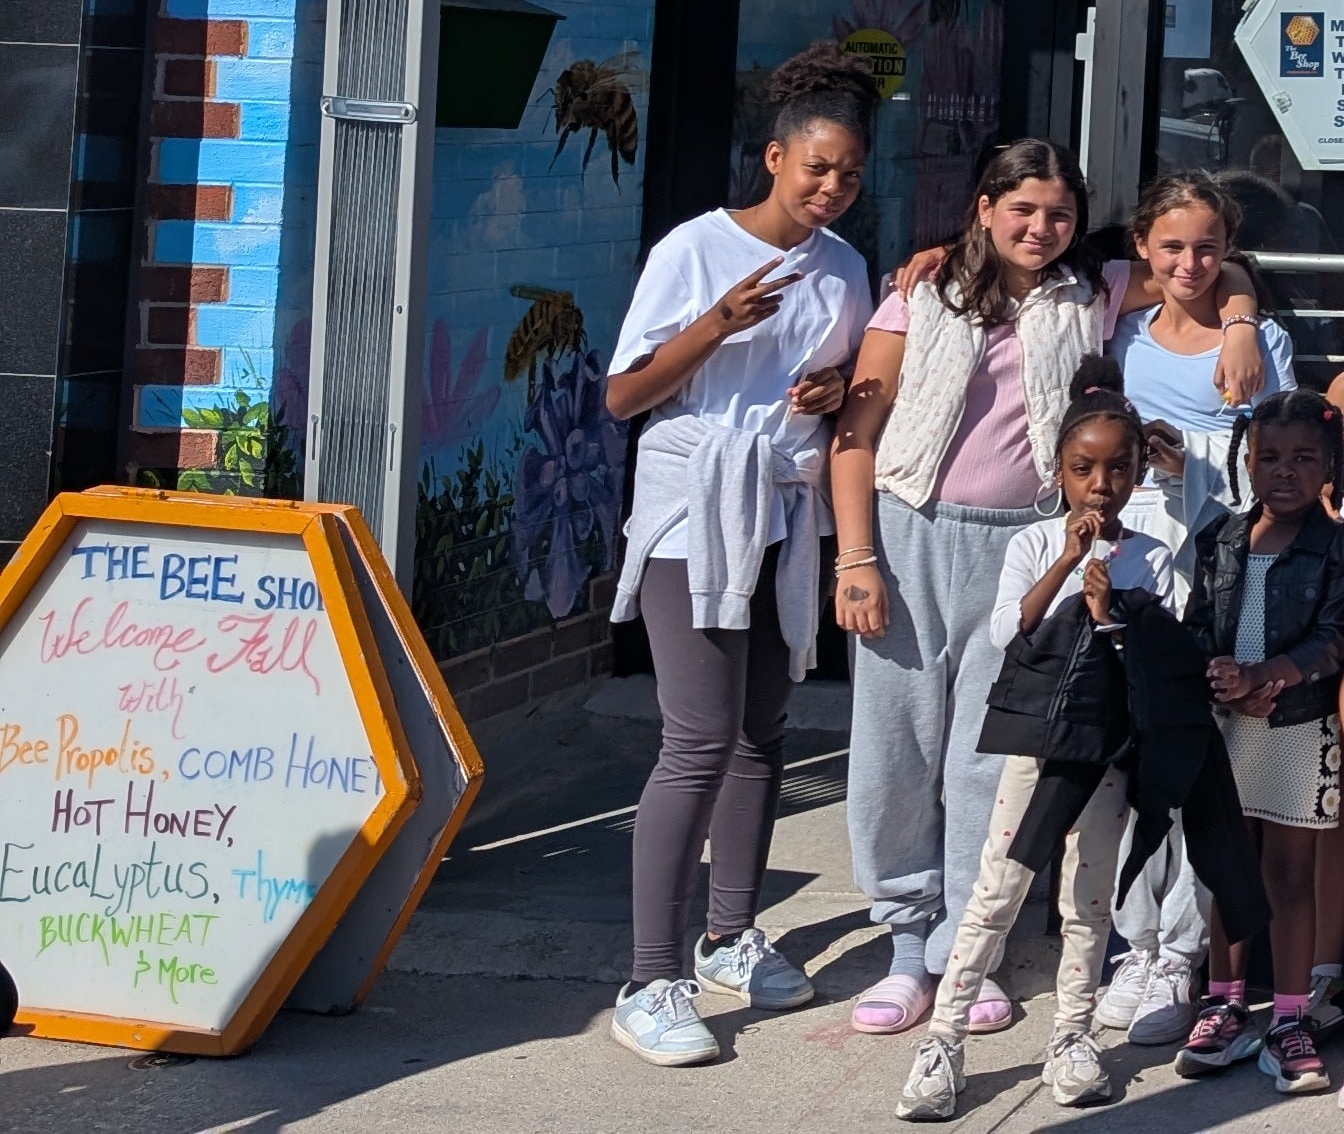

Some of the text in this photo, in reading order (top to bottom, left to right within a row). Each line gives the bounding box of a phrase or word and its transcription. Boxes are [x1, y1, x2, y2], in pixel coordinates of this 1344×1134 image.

[844, 41, 898, 54] AUTOMATIC
[1290, 51, 1307, 60] Bee
[1296, 59, 1319, 70] Shop
[72, 542, 154, 581] THE
[160, 553, 244, 604] BEE
[39, 597, 321, 696] Welcome Fall
[0, 723, 49, 775] Bee
[178, 747, 274, 782] COMB
[51, 788, 115, 836] HOT
[36, 912, 220, 966] BUCKWHEAT
[159, 956, 218, 1004] More
